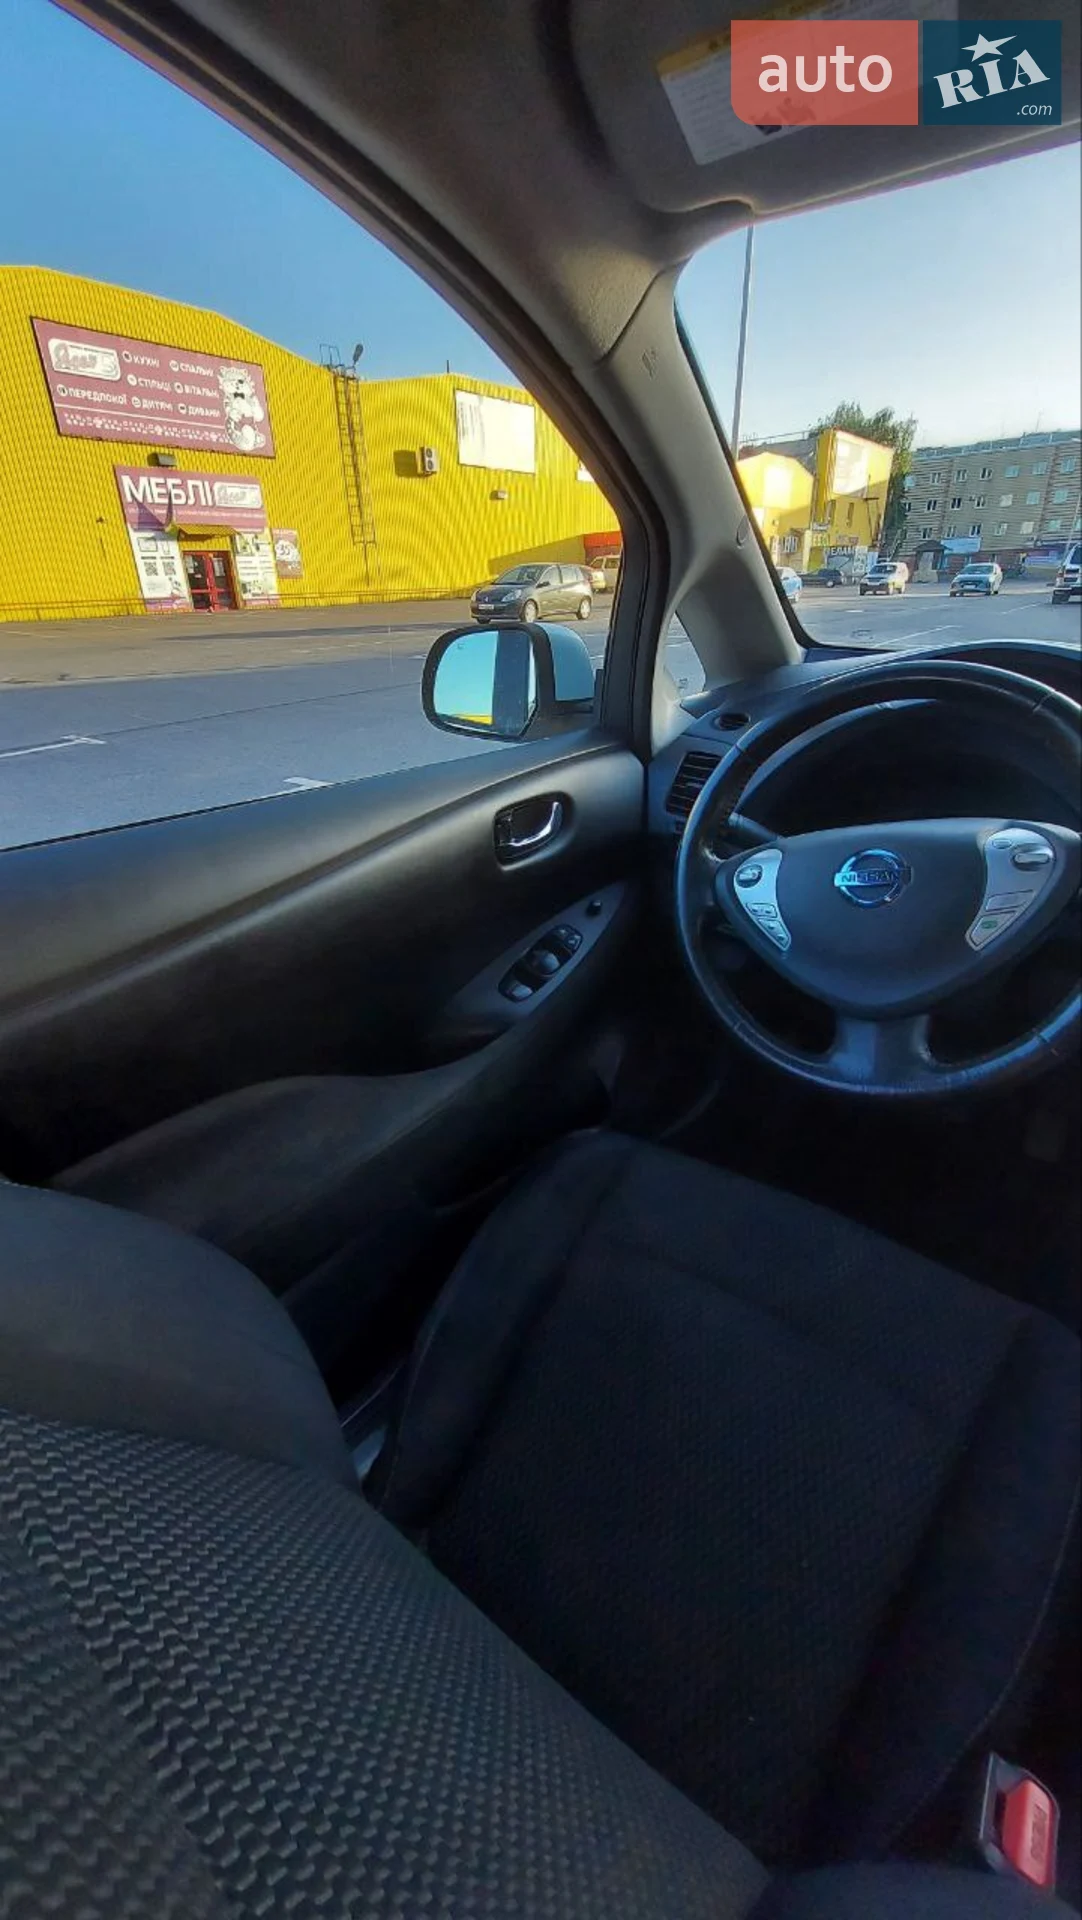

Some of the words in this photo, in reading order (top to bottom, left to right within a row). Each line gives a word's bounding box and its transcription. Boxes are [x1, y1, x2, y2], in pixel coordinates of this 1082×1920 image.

[133, 354, 160, 368] КУХНІ
[180, 362, 214, 377] СПАЛЬНІ
[137, 377, 171, 393] СТІЛЬЦІ
[69, 387, 127, 405] ПЕРЕДПОКОЇ
[188, 405, 221, 418] ДИВАНИ
[121, 475, 214, 506] МЕБЛІ
[841, 869, 901, 884] NISSAN
